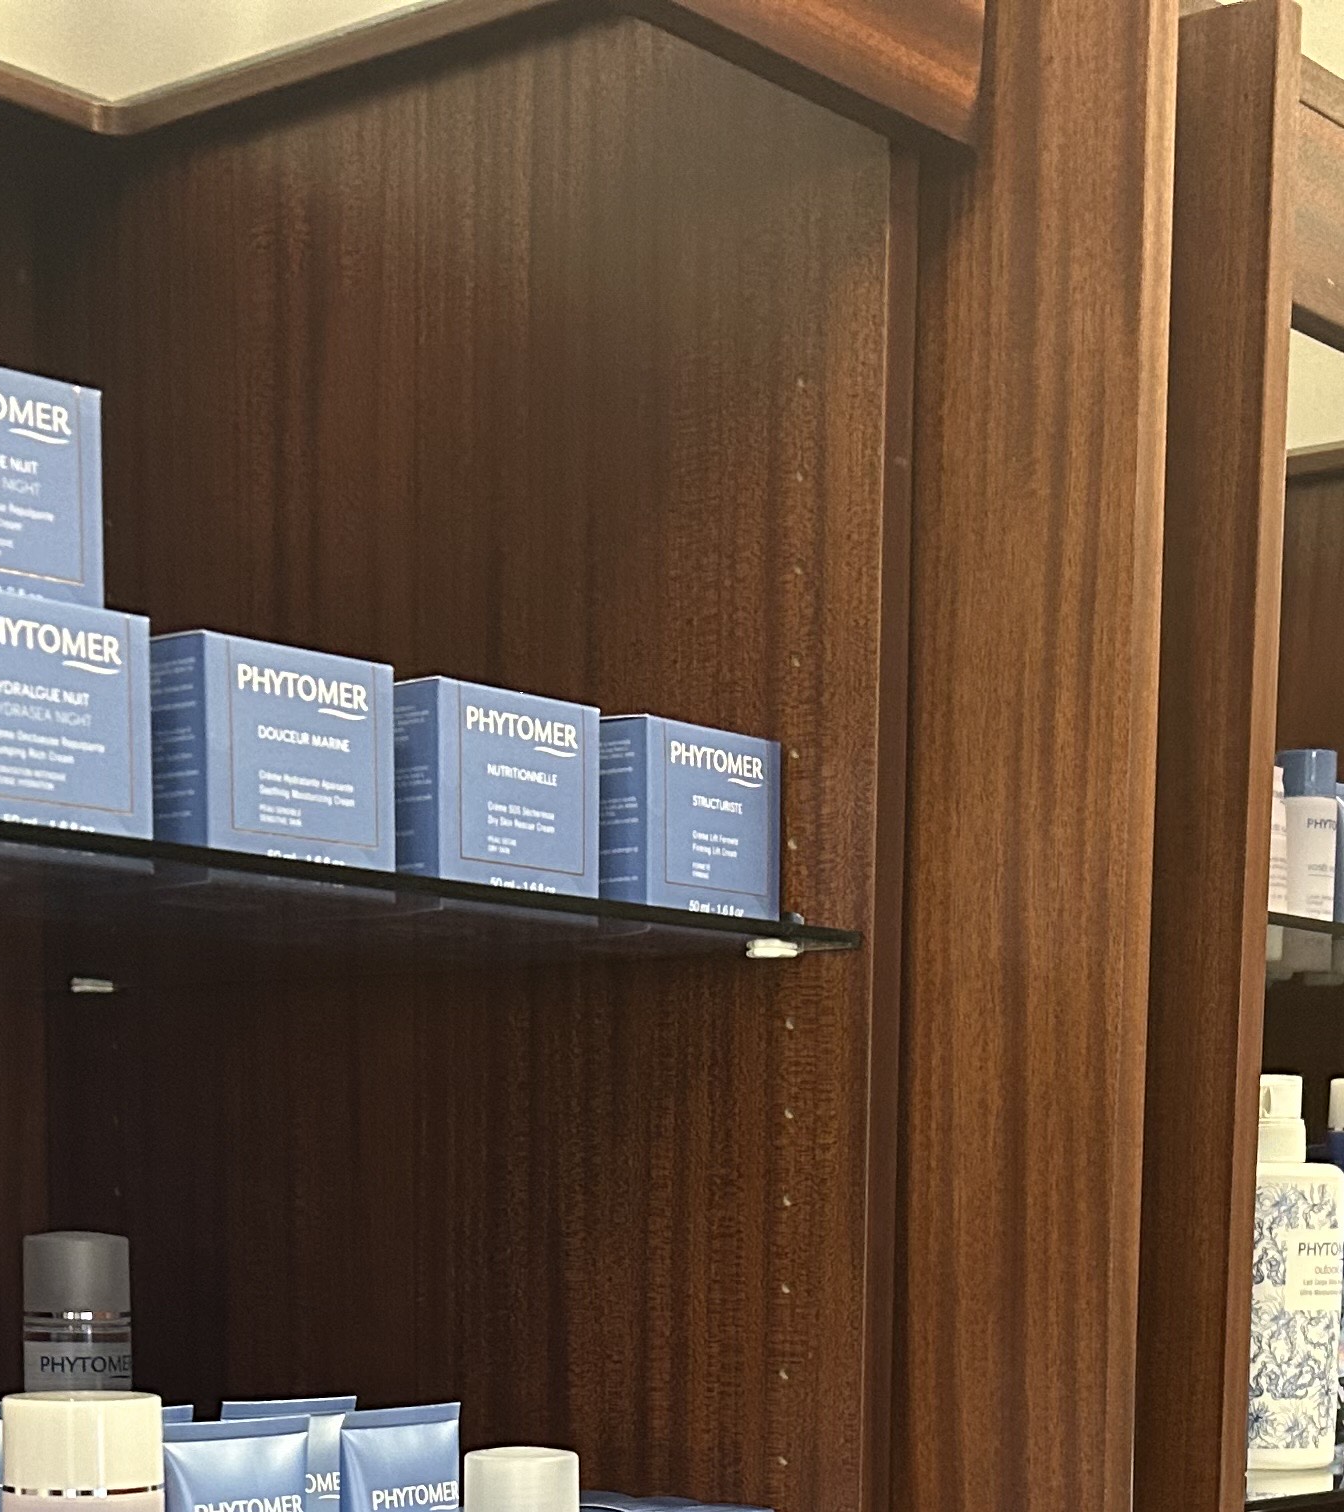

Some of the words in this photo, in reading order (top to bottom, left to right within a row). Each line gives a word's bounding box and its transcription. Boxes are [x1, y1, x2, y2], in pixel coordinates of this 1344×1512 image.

[9, 457, 39, 475] NUIT
[62, 690, 90, 707] NUIT
[237, 662, 369, 712] PHYTOMER
[258, 723, 310, 746] DOUCEUR
[311, 734, 351, 753] MARINE
[466, 704, 579, 750] PHYTOMER
[670, 740, 765, 781] PHYTOMER
[487, 763, 558, 787] NUTRITIONNELLE
[692, 794, 744, 816] STRUCTURISTE
[689, 899, 701, 912] 50
[372, 1480, 460, 1511] PHYTOMER
